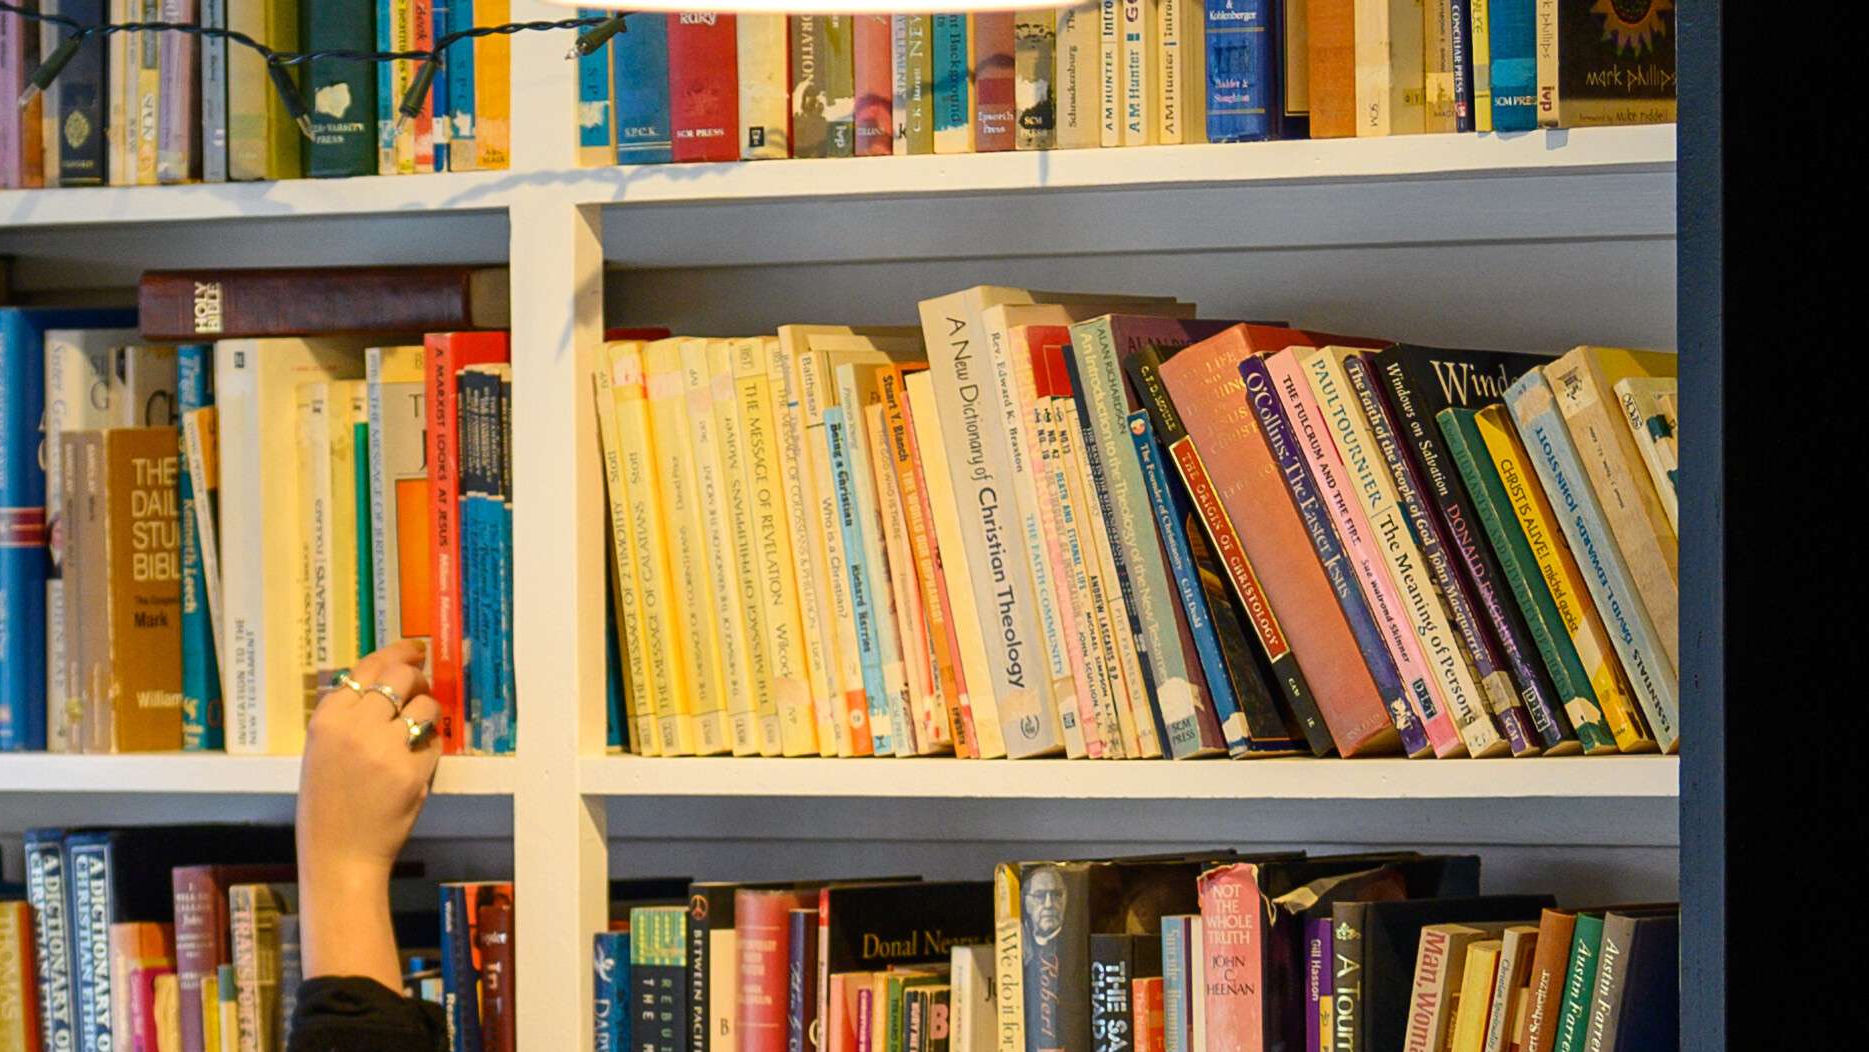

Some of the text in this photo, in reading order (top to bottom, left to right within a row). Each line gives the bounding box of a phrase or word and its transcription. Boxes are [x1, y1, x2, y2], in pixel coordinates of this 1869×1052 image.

[1452, 4, 1466, 94] CONCILIAR PRESS
[948, 30, 964, 122] Background
[1105, 50, 1114, 103] HUNTER
[1129, 49, 1140, 99] Hunter
[1105, 106, 1114, 118] M
[1129, 103, 1140, 116] M
[194, 283, 208, 333] HOLY
[207, 281, 223, 333] BIBLE
[435, 347, 443, 357] A
[435, 364, 446, 428] MARXIST
[744, 384, 759, 413] THE
[800, 355, 819, 418] Balthasar
[132, 457, 178, 486] THE
[437, 433, 447, 482] LOOKS
[748, 416, 770, 484] MESSAGE
[1385, 362, 1412, 418] Windows
[1412, 421, 1423, 438] on
[1419, 440, 1448, 496] Salvation
[1447, 504, 1486, 577] DONALD
[132, 490, 178, 517] DAIL
[438, 488, 447, 506] AT
[757, 488, 771, 511] OF
[822, 497, 835, 524] Who
[945, 316, 1027, 690] A New Dictionary of Christian Theology
[438, 509, 449, 548] JESUS
[826, 526, 837, 539] is
[1181, 452, 1278, 646] THE ORIGIN OF CHRISTOLOGY
[1282, 460, 1308, 493] The
[1298, 494, 1333, 553] Easter
[1323, 556, 1353, 600] Jesus
[1311, 359, 1477, 726] PAUL TOURNIER The Meaning of Persons
[183, 499, 197, 613] Kenneth Leech
[439, 553, 450, 594] Milan
[761, 514, 783, 606] REVELATION
[830, 557, 847, 618] Christian?
[134, 611, 168, 630] Mark
[89, 857, 105, 876] A
[1212, 884, 1243, 900] NOT
[1215, 899, 1240, 915] THE
[75, 855, 94, 979] CHRISTIAN
[1206, 914, 1253, 930] WHOLE
[1207, 929, 1251, 945] TRUTH
[90, 878, 111, 1023] DICTIONARY
[692, 929, 704, 1001] BETWEEN
[1001, 930, 1019, 967] We
[1211, 954, 1245, 970] JOHN
[1337, 953, 1360, 977] A
[1415, 929, 1447, 989] Man,
[1570, 938, 1593, 998] Austin
[642, 978, 654, 1021] THE
[1002, 972, 1019, 998] do
[1041, 953, 1059, 1038] Robert
[1091, 961, 1107, 1039] CHAD
[1106, 960, 1128, 1012] THE
[1205, 980, 1255, 997] HEENAN
[1004, 1001, 1021, 1018] it
[1004, 1020, 1022, 1045] for
